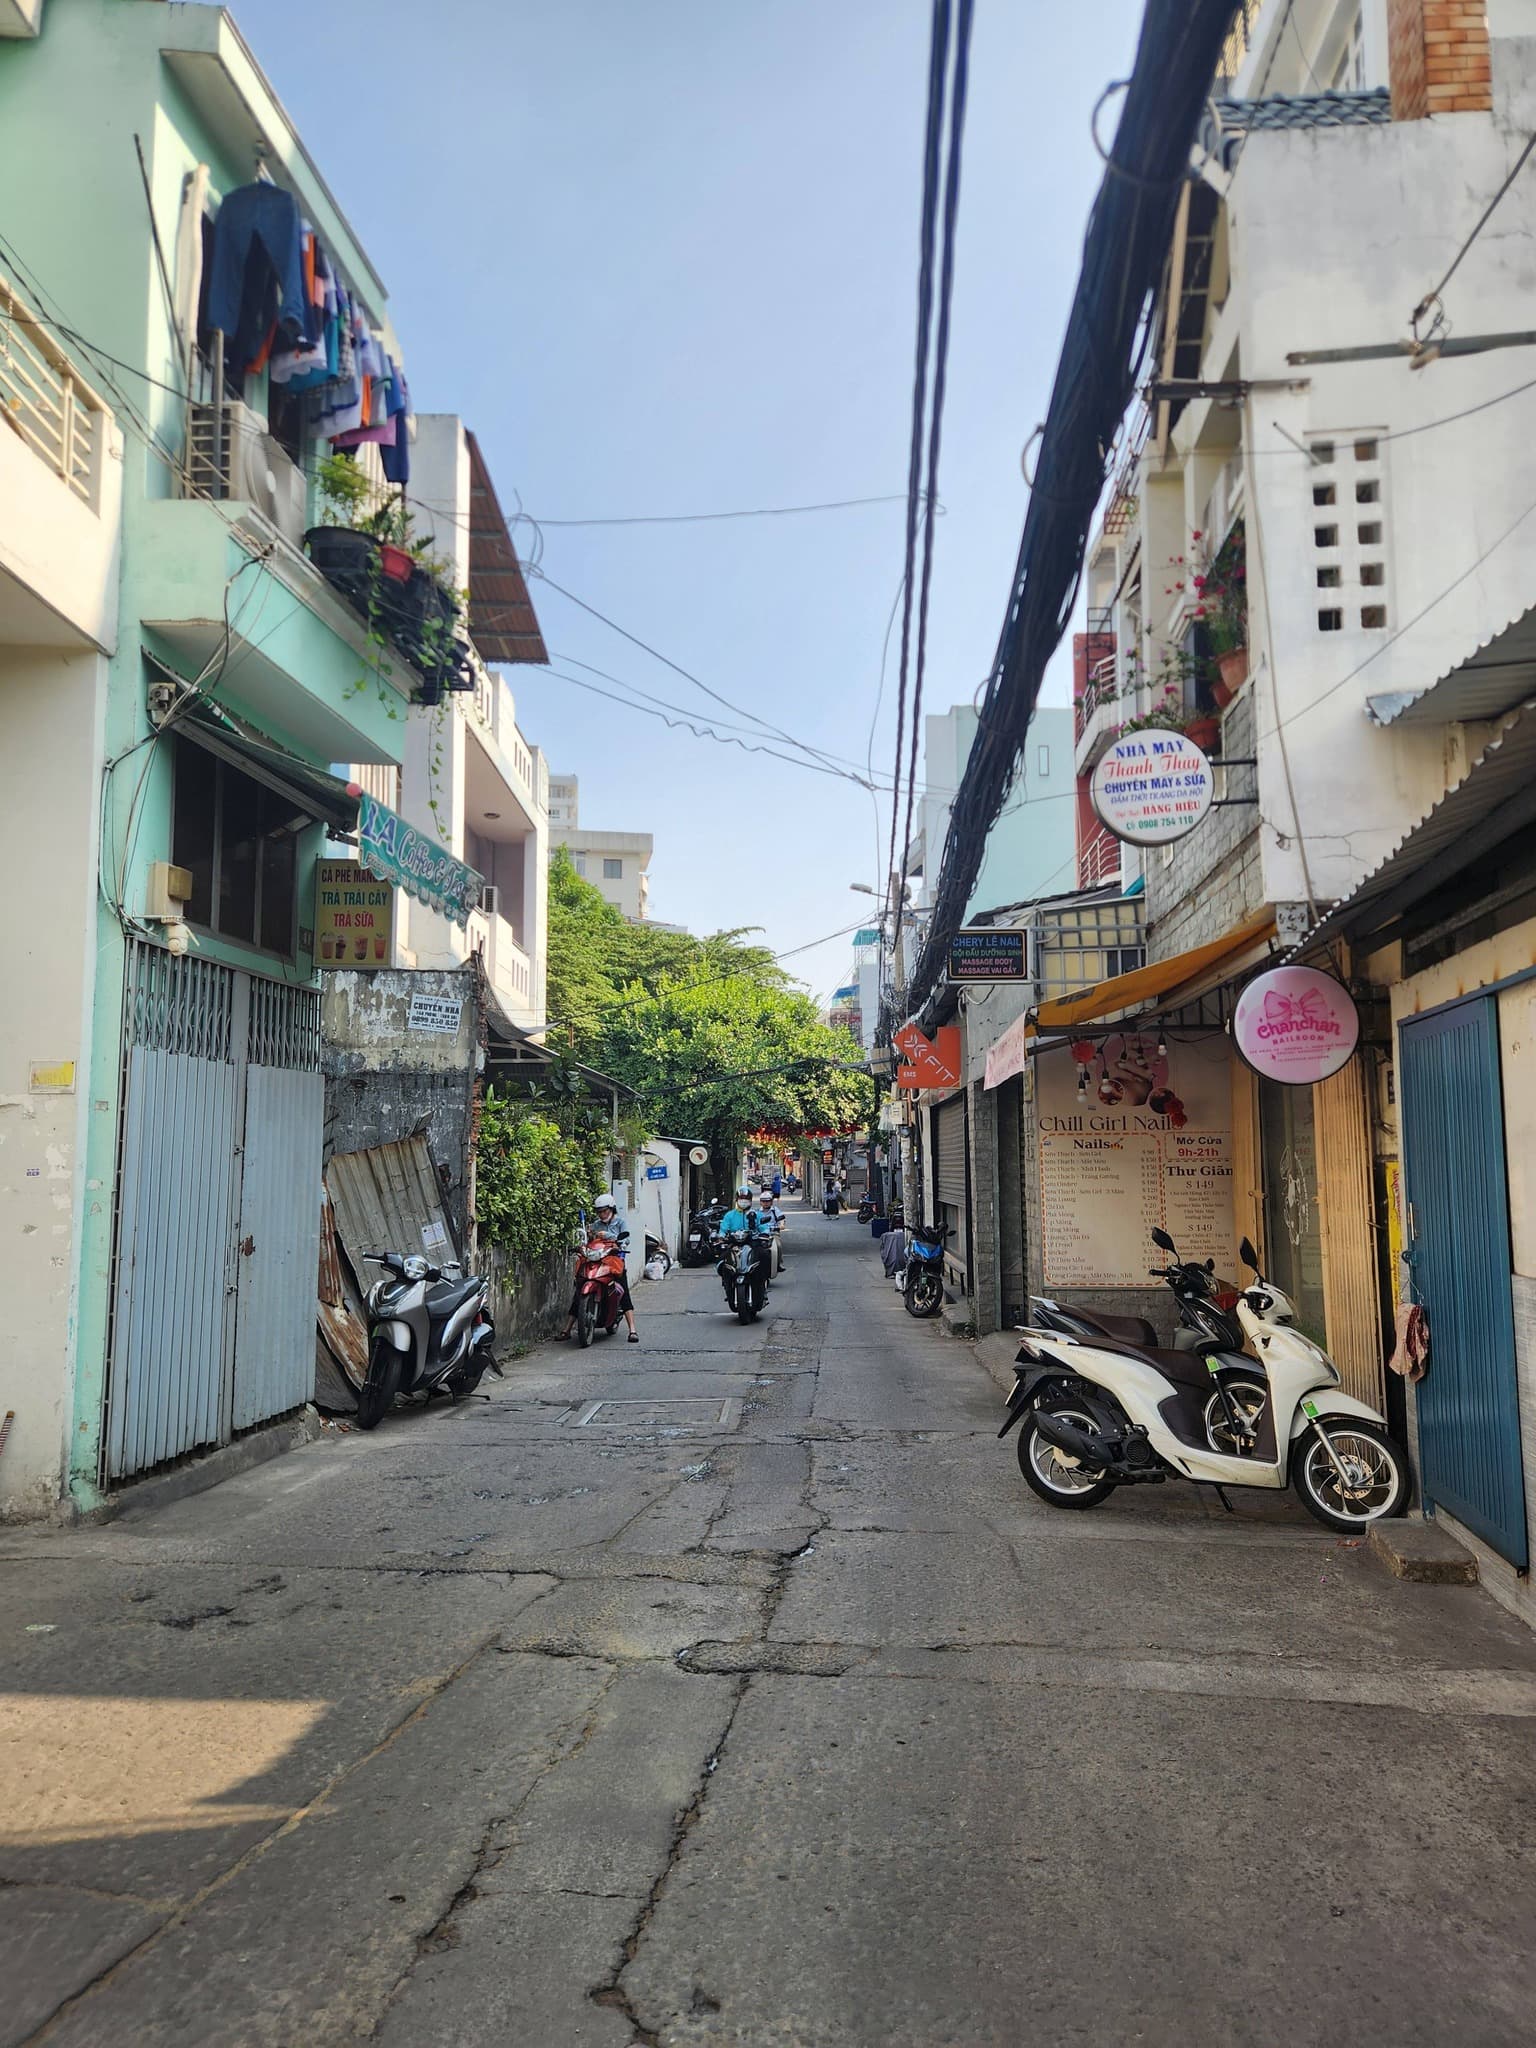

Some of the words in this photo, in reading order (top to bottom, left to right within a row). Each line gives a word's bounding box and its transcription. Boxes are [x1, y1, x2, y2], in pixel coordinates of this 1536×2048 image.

[1116, 742, 1146, 758] NHÀ
[1152, 740, 1184, 754] MAY
[1104, 758, 1152, 778] Thanh
[1105, 778, 1147, 794] CHUYÊN
[1151, 778, 1173, 790] MAY
[1179, 815, 1194, 825] 110
[361, 802, 397, 856] LA
[399, 829, 433, 879] Coffee
[434, 858, 446, 885] &
[442, 861, 465, 899] Tea
[354, 868, 378, 883] MAN
[344, 889, 365, 905] TRÁI
[368, 889, 388, 906] CÂY
[355, 910, 374, 927] SỮA
[953, 937, 984, 947] CHERY
[986, 935, 998, 946] LÊ
[1000, 937, 1022, 946] NAIL
[1272, 1034, 1325, 1045] NAILROOM
[924, 1055, 955, 1081] FIT
[1040, 1116, 1083, 1131] Chill
[1090, 1116, 1126, 1131] Girl
[1073, 1139, 1110, 1149] Nails
[1177, 1136, 1195, 1145] Mở
[1198, 1136, 1222, 1145] Cửa
[1178, 1148, 1219, 1156] 9h-21h
[1166, 1165, 1197, 1176] Thư
[1200, 1165, 1233, 1176] Giãn
[1197, 1180, 1214, 1189] 149
[1197, 1224, 1213, 1232] 149
